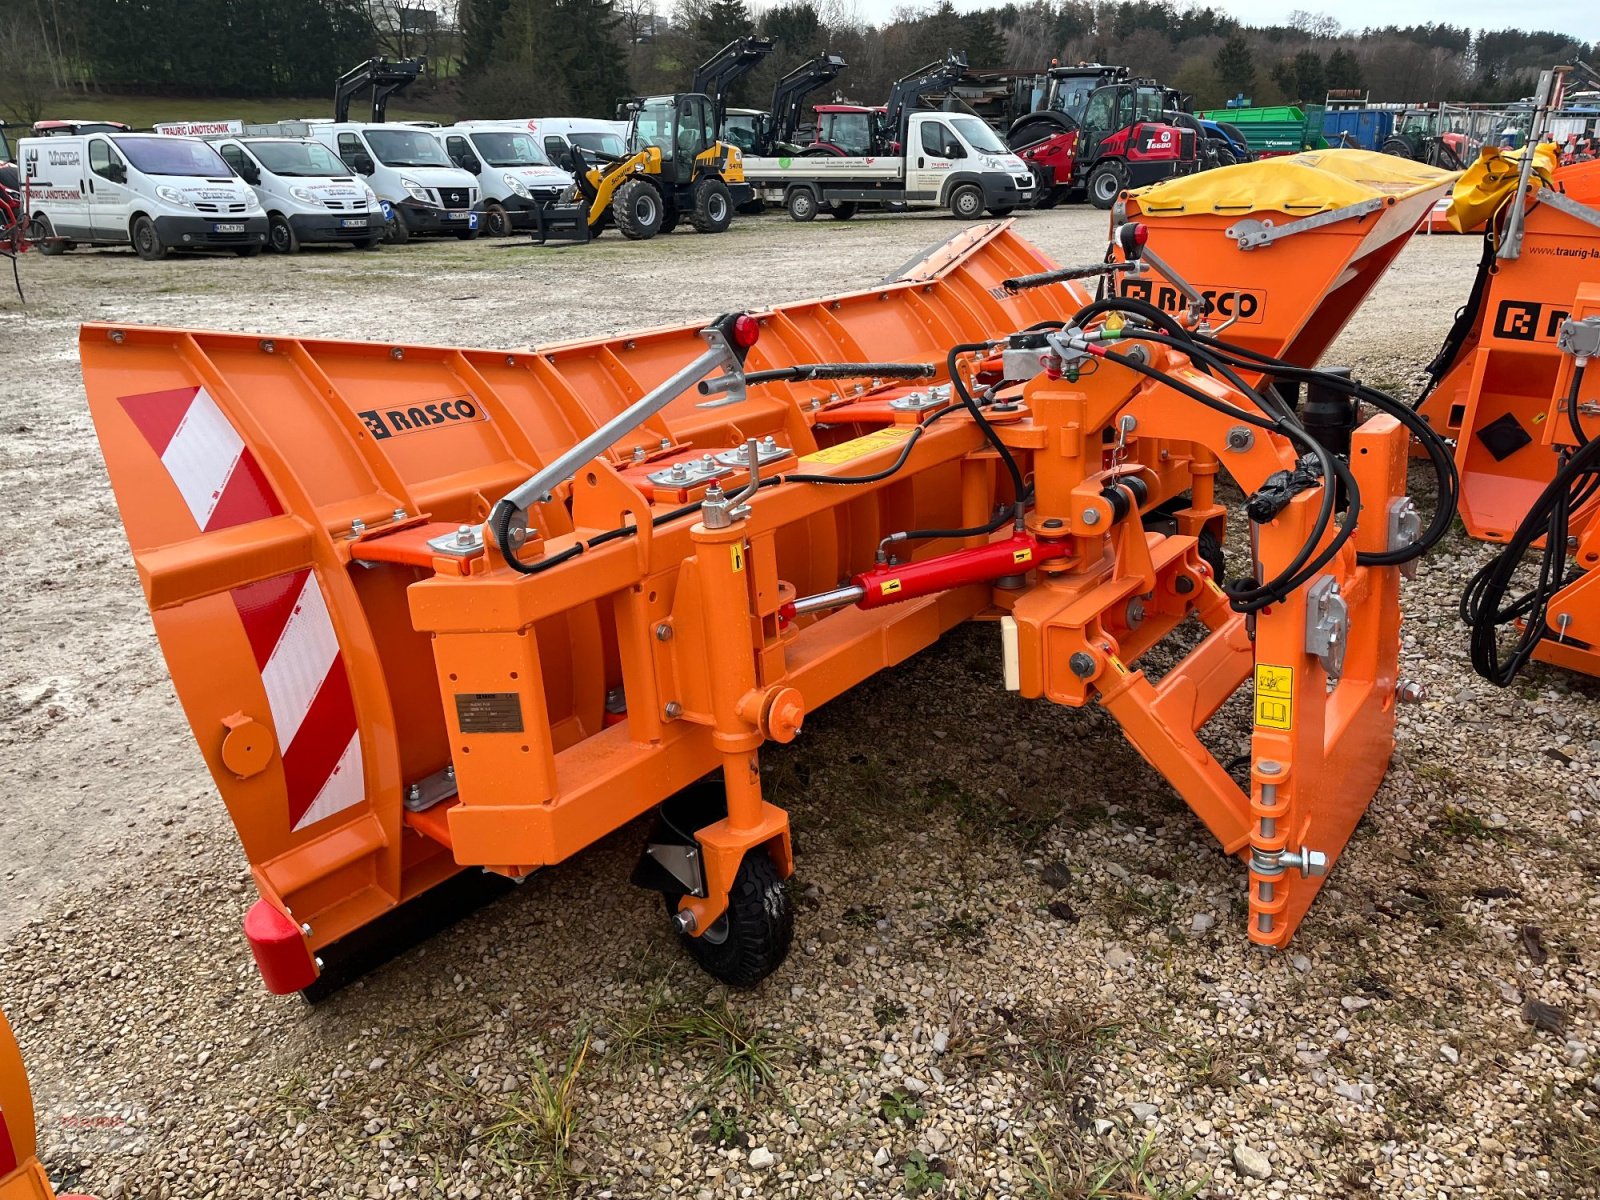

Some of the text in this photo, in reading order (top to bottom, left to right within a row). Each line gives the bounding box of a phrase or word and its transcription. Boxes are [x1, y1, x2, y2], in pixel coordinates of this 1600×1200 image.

[162, 124, 229, 135] TRAURIG LANDTECHNIK
[22, 190, 81, 200] TAURIG LANDTECHNIK
[381, 203, 391, 218] P
[469, 214, 477, 226] P
[1529, 247, 1600, 259] www.traurig-la
[386, 400, 476, 431] RASCO
